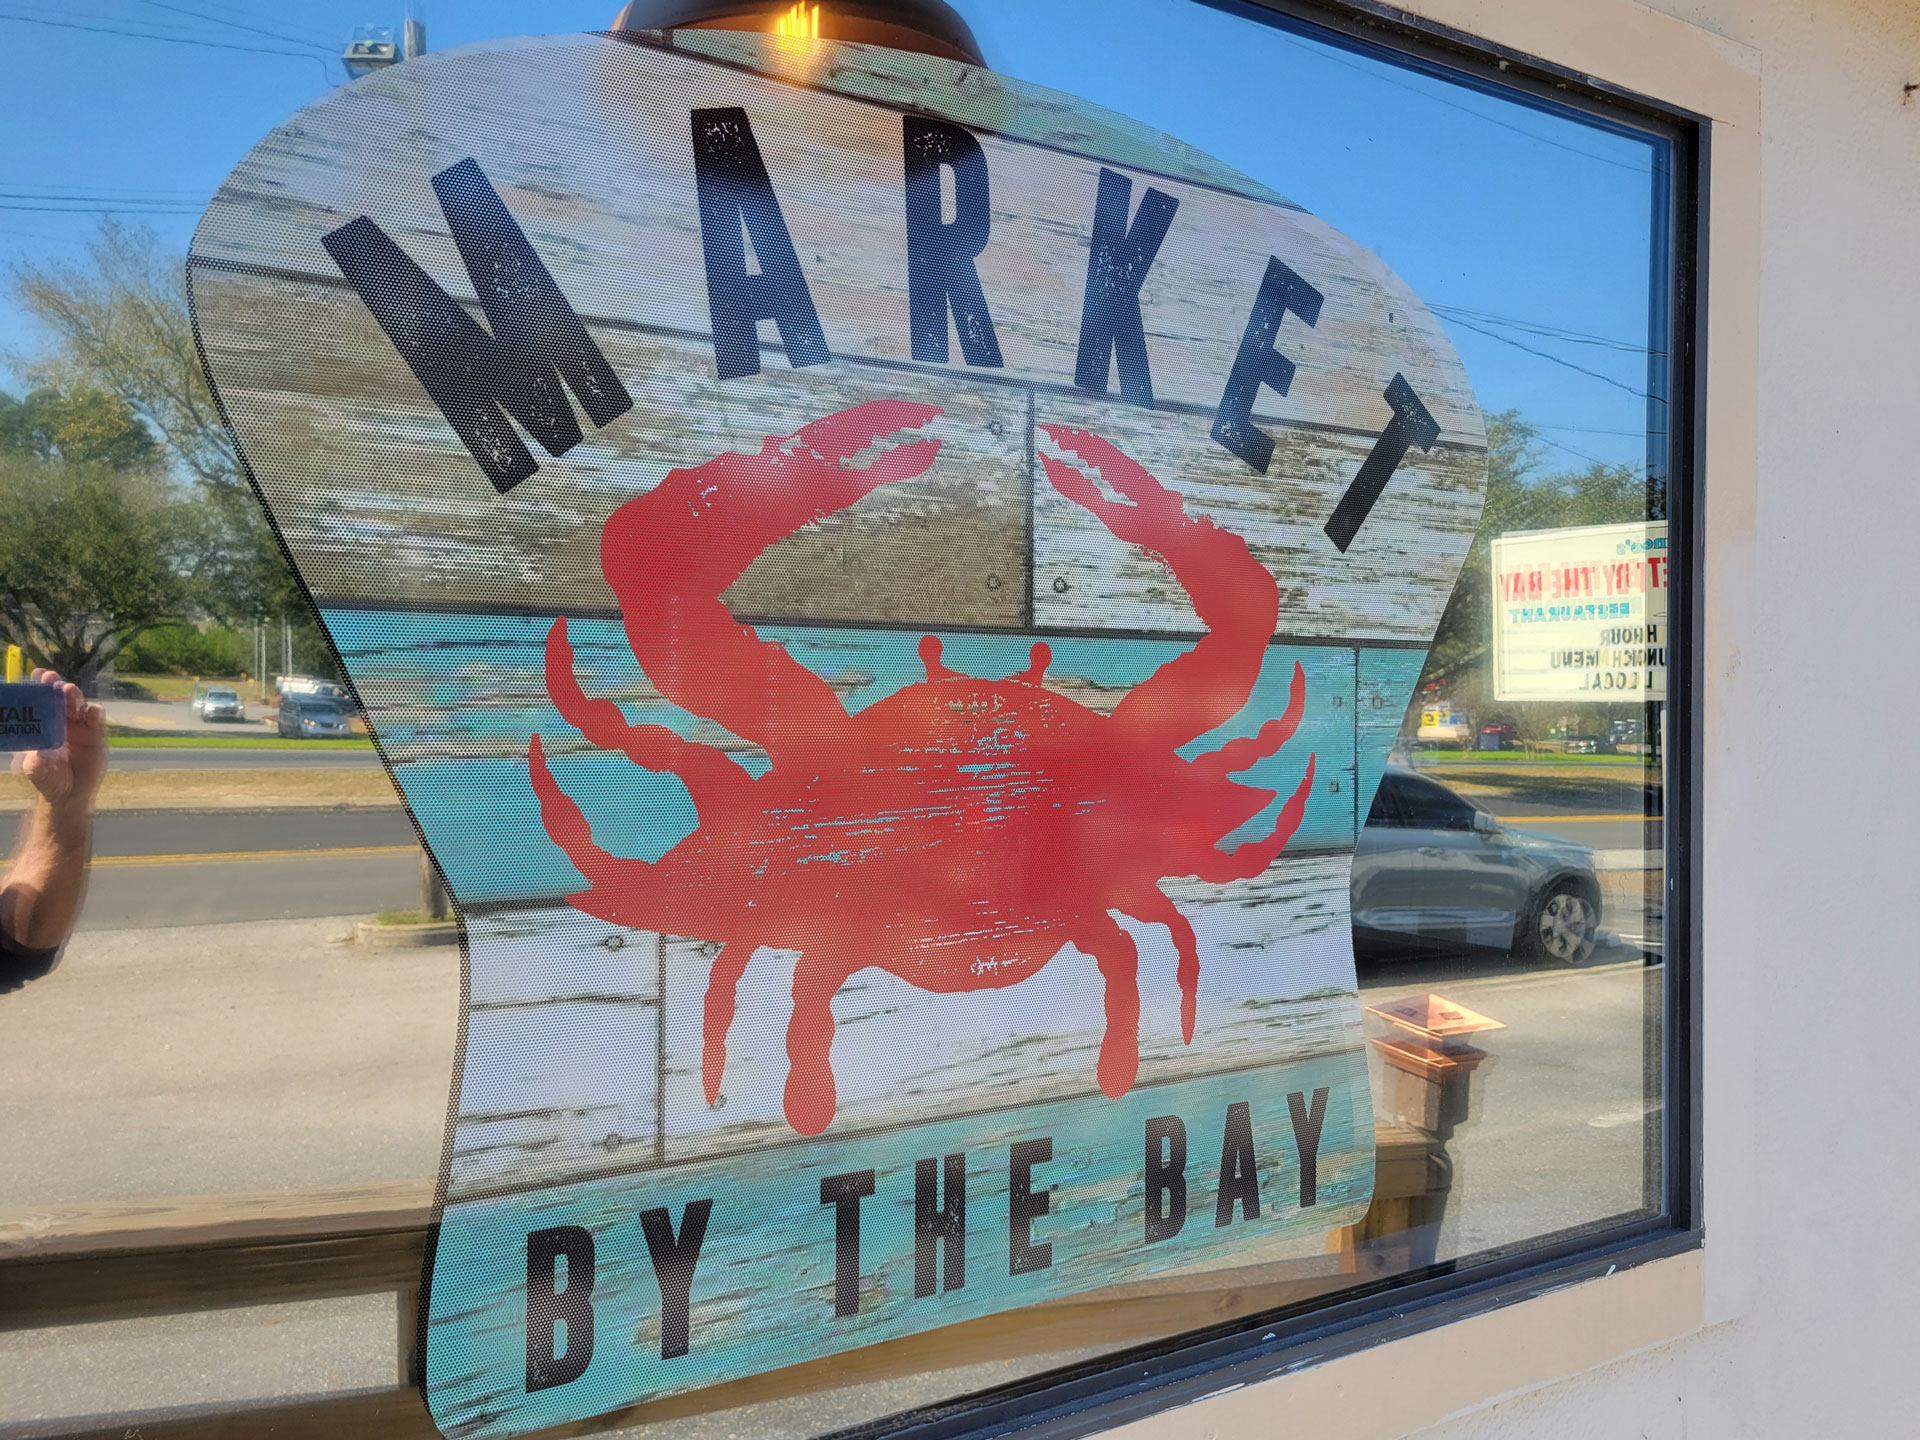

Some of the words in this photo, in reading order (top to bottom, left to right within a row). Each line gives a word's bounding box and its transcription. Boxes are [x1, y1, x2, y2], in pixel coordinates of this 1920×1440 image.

[321, 107, 1441, 554] MARKET
[526, 1199, 713, 1393] BY
[820, 1137, 1052, 1318] THE
[1145, 1087, 1329, 1244] BAY
